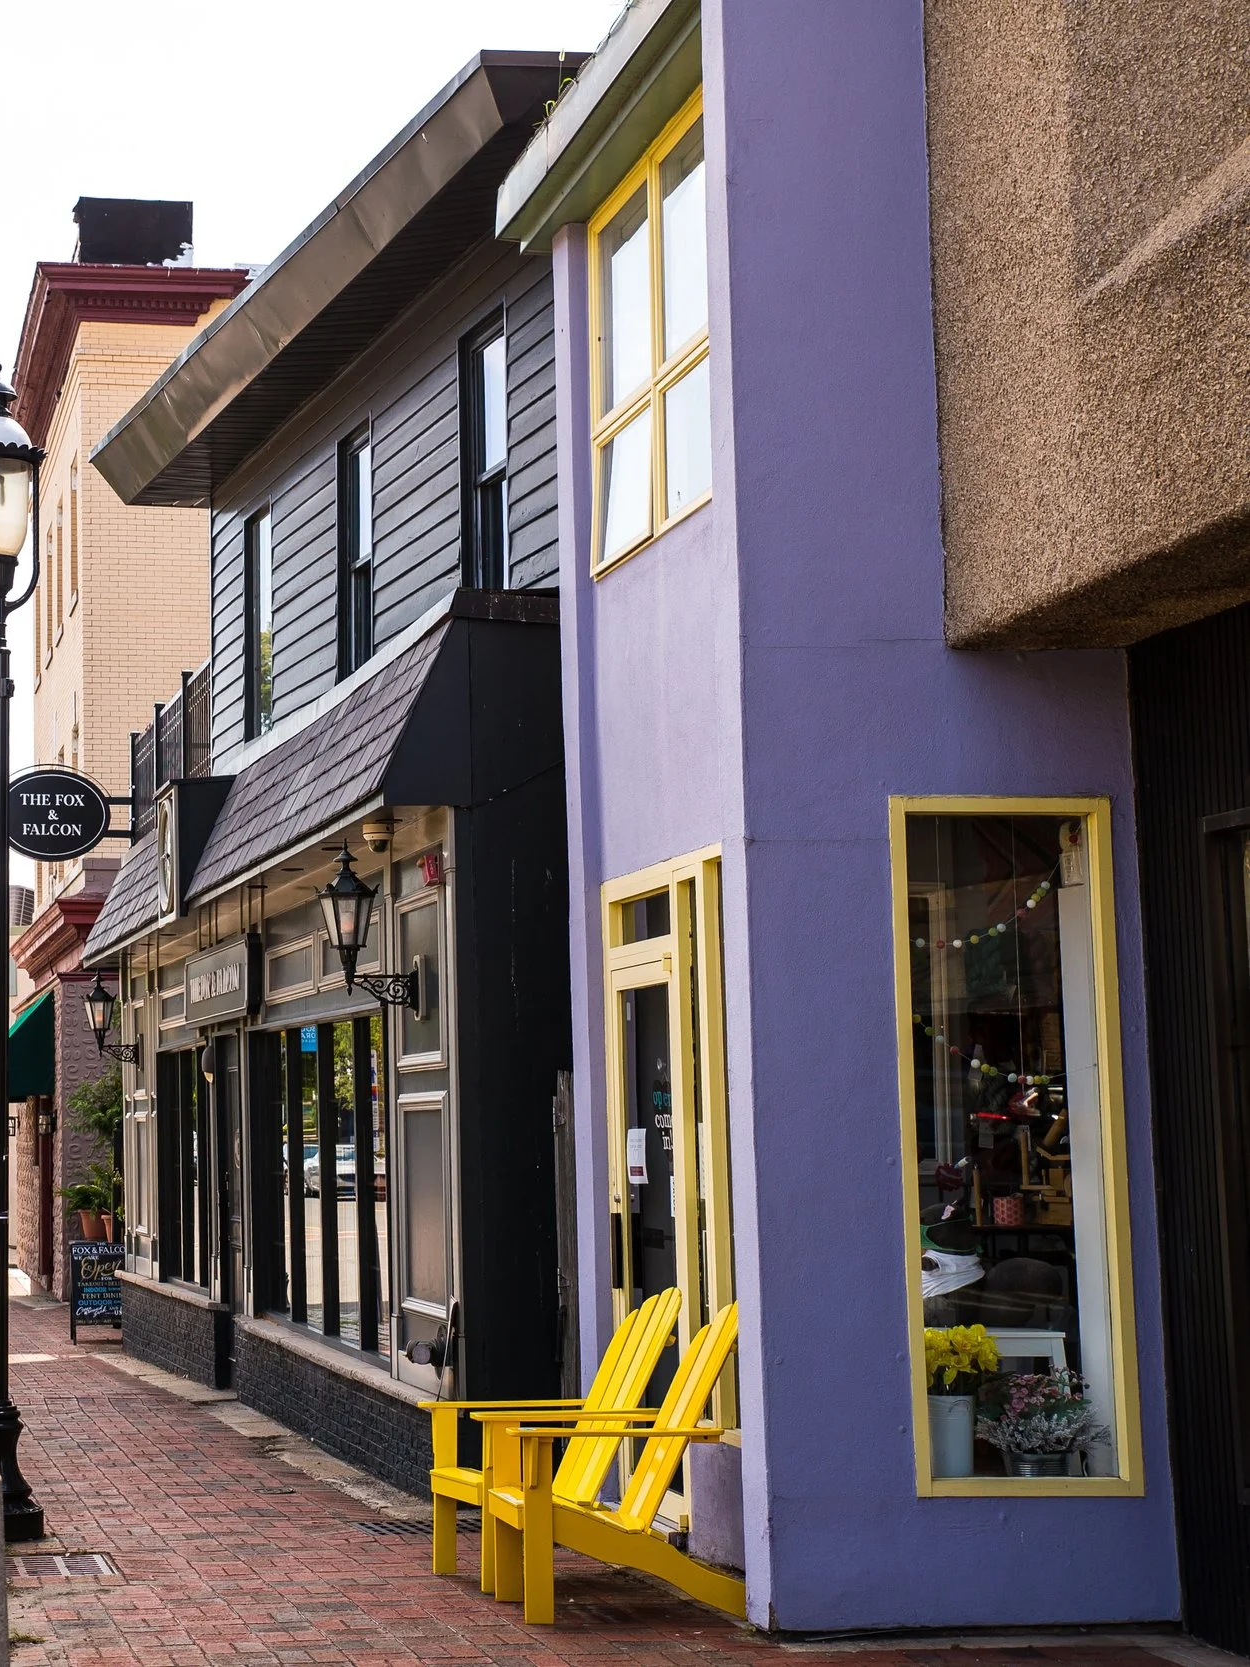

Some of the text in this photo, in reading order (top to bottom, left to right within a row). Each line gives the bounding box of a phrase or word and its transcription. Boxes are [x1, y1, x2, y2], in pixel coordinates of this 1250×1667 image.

[20, 793, 85, 807] THE FOX
[48, 809, 59, 820] &
[22, 823, 82, 836] FALCON
[655, 1114, 673, 1128] com
[72, 1246, 125, 1255] FOX & FALCO
[81, 1256, 123, 1281] Open
